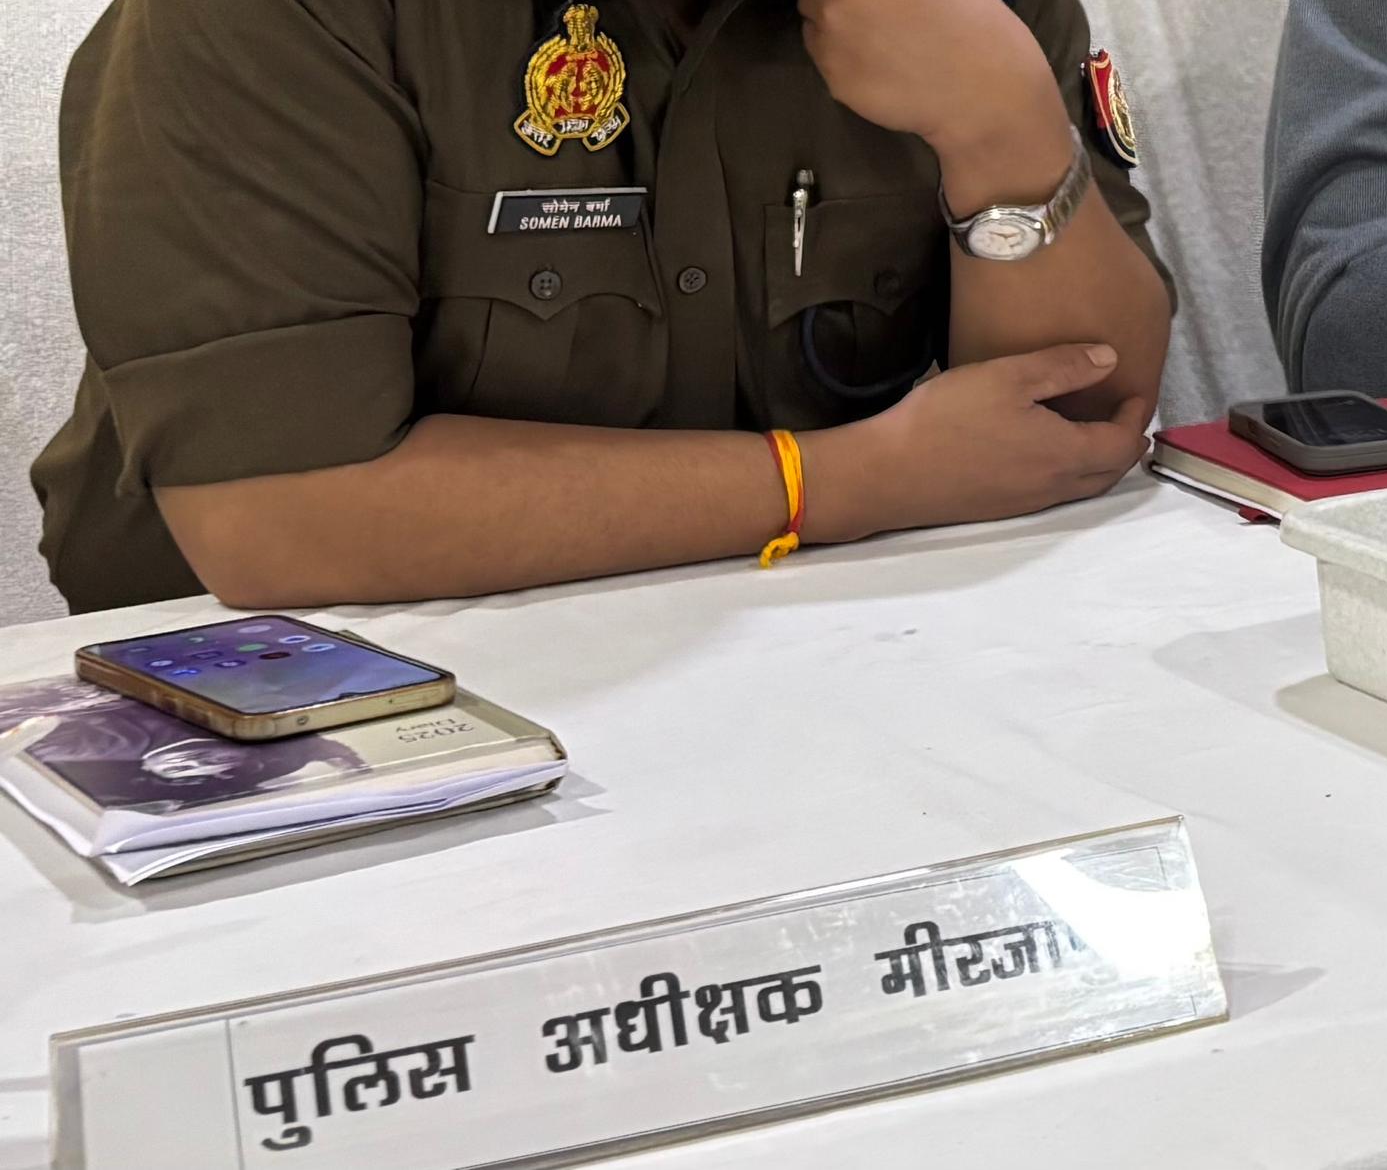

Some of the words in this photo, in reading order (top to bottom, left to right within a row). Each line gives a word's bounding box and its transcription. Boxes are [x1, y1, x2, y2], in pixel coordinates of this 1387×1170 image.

[520, 215, 570, 230] SOMEN
[574, 214, 622, 229] BARMA
[398, 723, 474, 744] 2025
[244, 1034, 476, 1151] पुलिस
[541, 964, 824, 1075] अधीक्षक
[873, 920, 1086, 999] मीरजा
